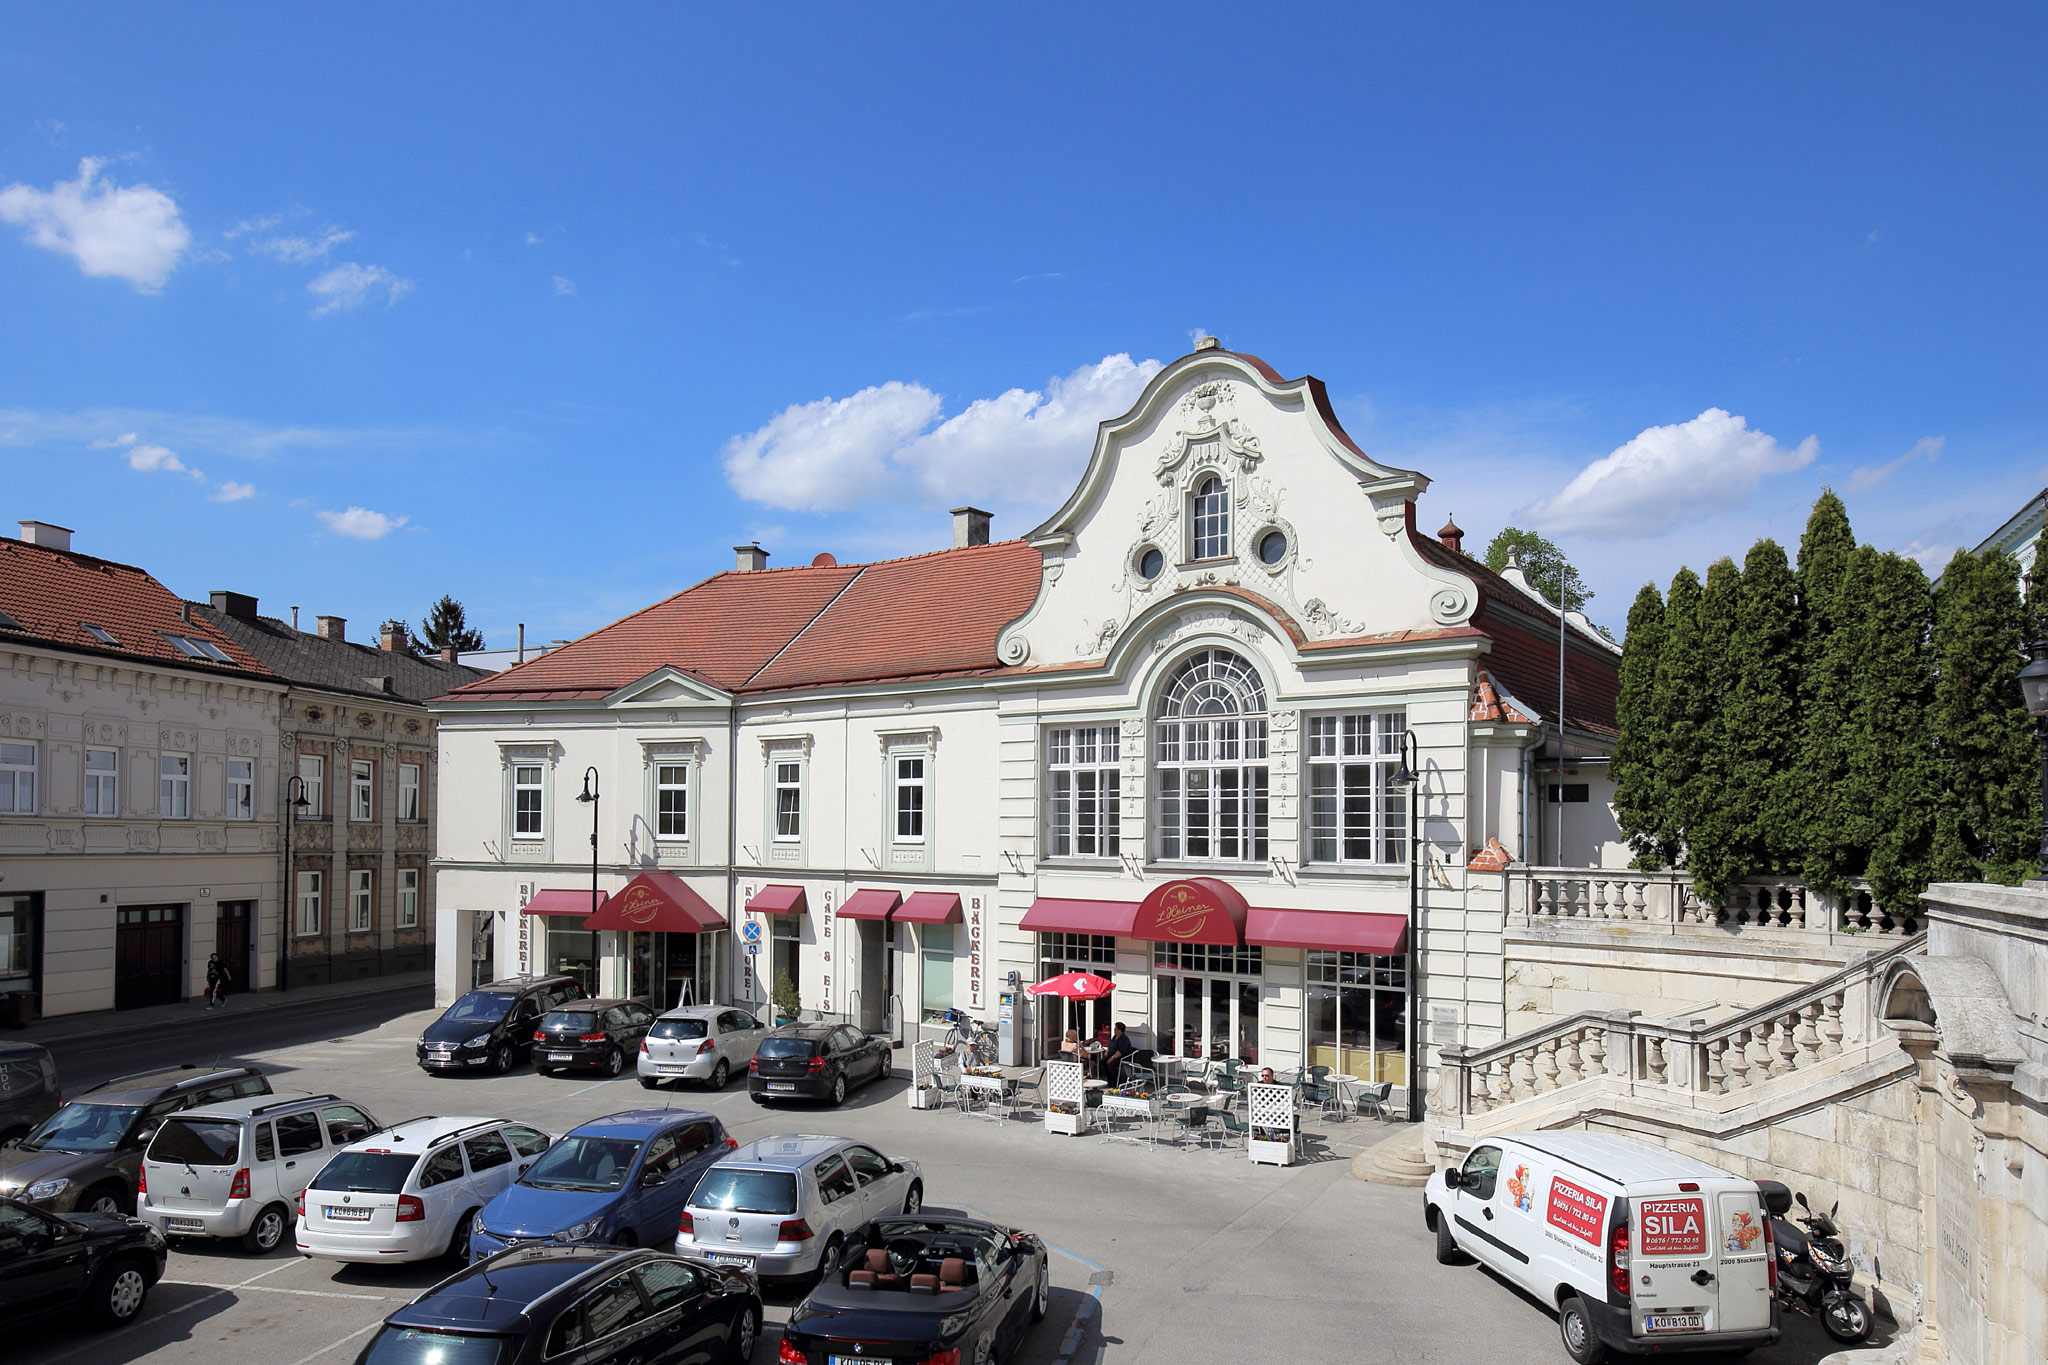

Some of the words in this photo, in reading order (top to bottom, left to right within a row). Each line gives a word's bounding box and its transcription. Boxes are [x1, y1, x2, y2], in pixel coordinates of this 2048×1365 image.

[1185, 612, 1226, 630] 1900
[1166, 904, 1210, 919] Heiner
[970, 897, 981, 1005] BÄCKEREI
[1008, 972, 1015, 984] P
[823, 975, 831, 1011] EIS
[1553, 1181, 1584, 1204] PIZZERIA
[1585, 1195, 1602, 1212] SILA
[1572, 1207, 1582, 1218] 772
[1643, 1202, 1699, 1213] PIZZERIA
[1645, 1215, 1700, 1235] SILA
[1650, 1261, 1691, 1269] Hauptstrasse
[1654, 1317, 1667, 1328] KO
[1672, 1317, 1687, 1327] 813
